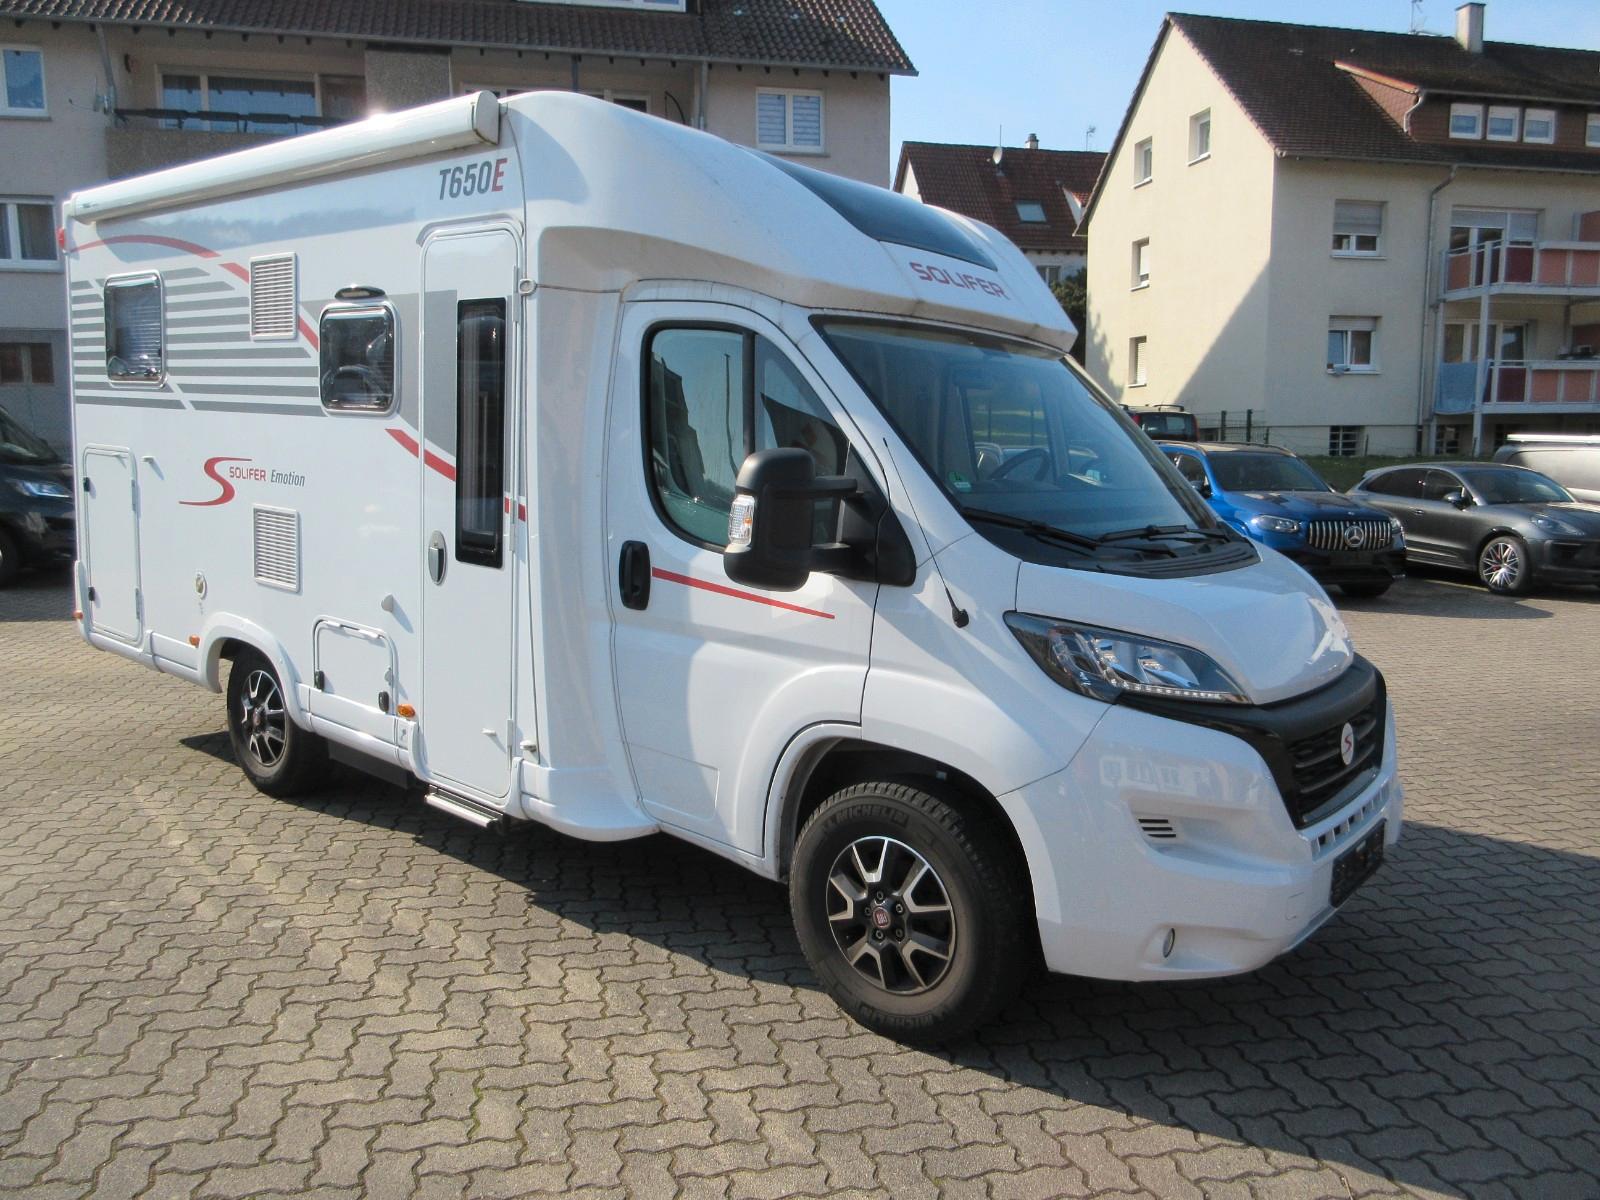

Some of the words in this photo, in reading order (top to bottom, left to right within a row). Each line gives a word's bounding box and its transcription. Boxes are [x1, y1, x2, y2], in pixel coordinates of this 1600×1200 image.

[439, 158, 508, 200] T650E
[910, 262, 1010, 300] SOLIFER
[229, 466, 266, 481] SOLIFER
[270, 469, 305, 487] Emotion
[835, 804, 909, 829] MICHELIN
